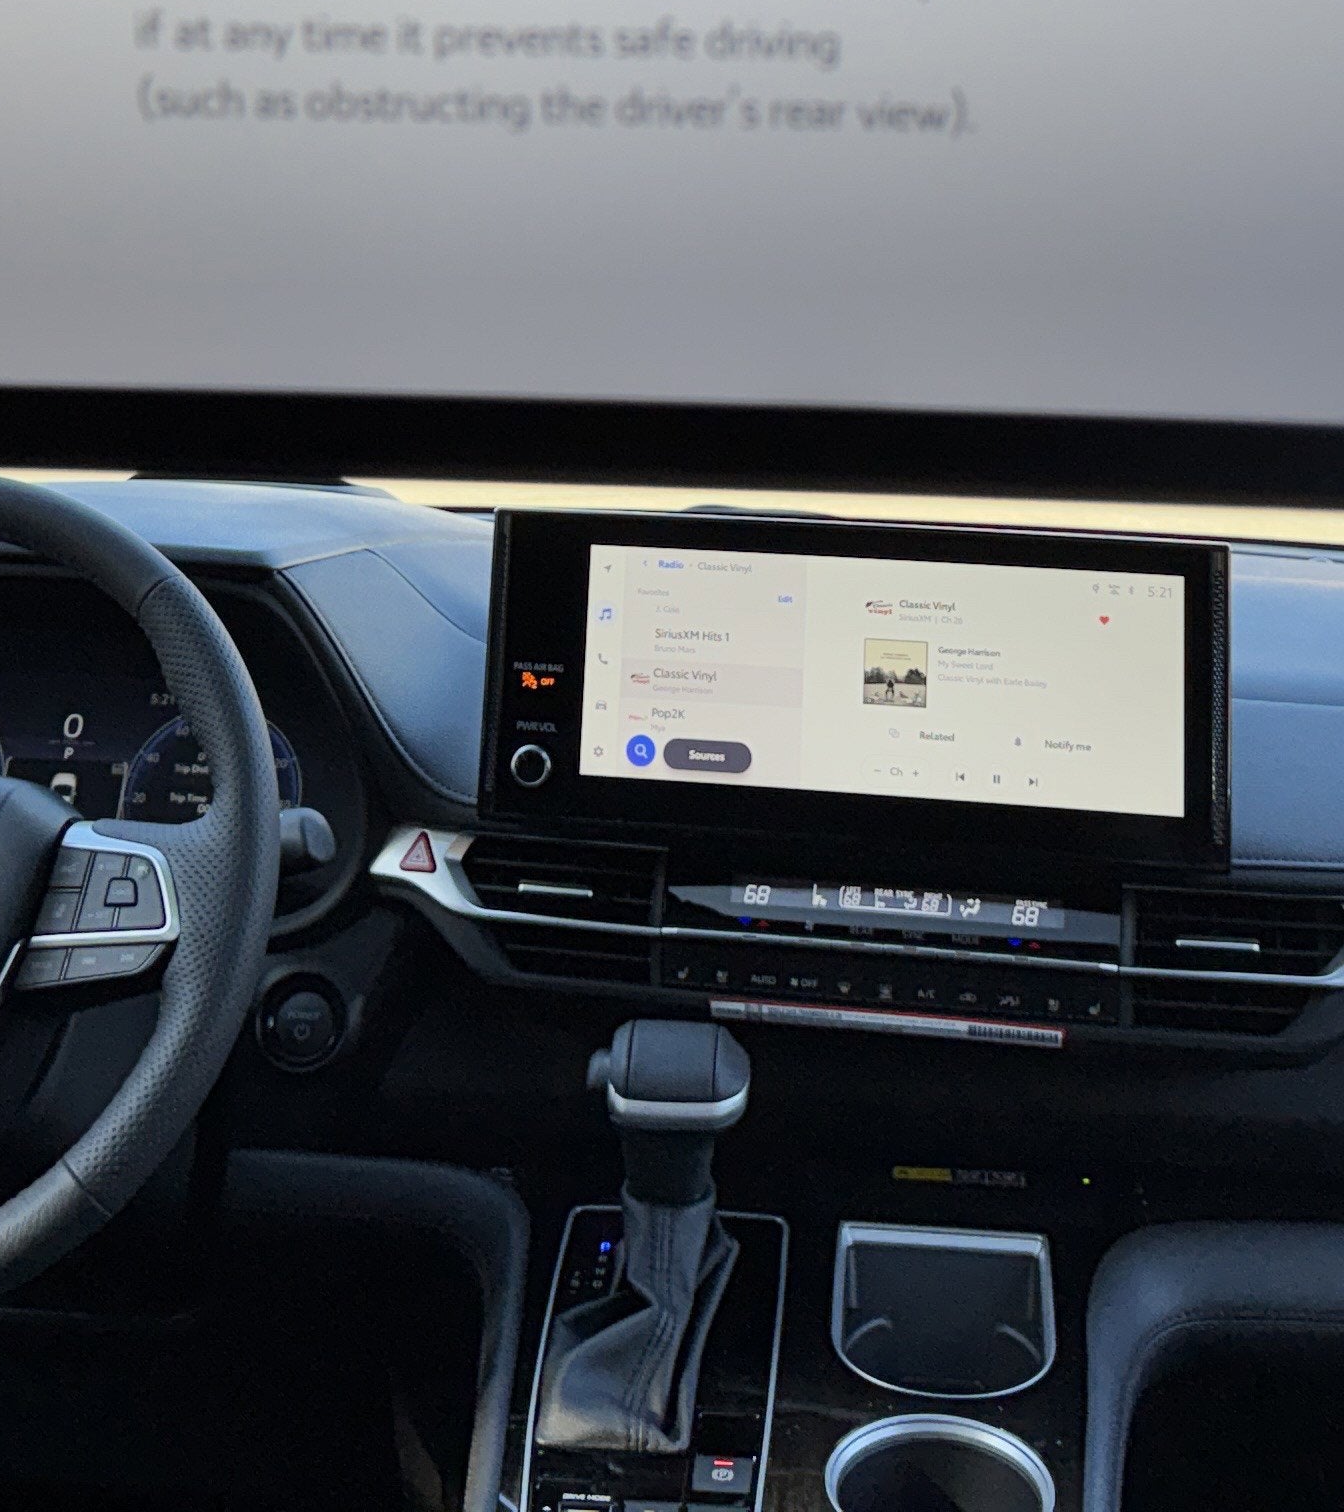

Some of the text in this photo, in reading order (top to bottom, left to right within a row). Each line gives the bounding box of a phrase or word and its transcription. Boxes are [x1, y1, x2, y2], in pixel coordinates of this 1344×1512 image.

[133, 6, 843, 73] if at any time it prevents safe driving
[135, 71, 979, 142] (such as obstructing the driver's rear view).
[658, 559, 753, 575] Radio Classic Vinyl
[899, 599, 956, 612] Classic Vinyl
[655, 627, 700, 641] SiriusXM
[702, 631, 723, 642] Hits
[937, 646, 1002, 658] George Harrison
[653, 667, 689, 681] Classic
[691, 669, 718, 683] Vinyl
[651, 707, 686, 720] Pop2K
[63, 713, 84, 739] 0
[919, 730, 955, 742] Related
[1044, 739, 1092, 752] Notify me
[688, 749, 726, 763] Sources
[743, 883, 772, 906] 68
[1011, 905, 1040, 927] 68
